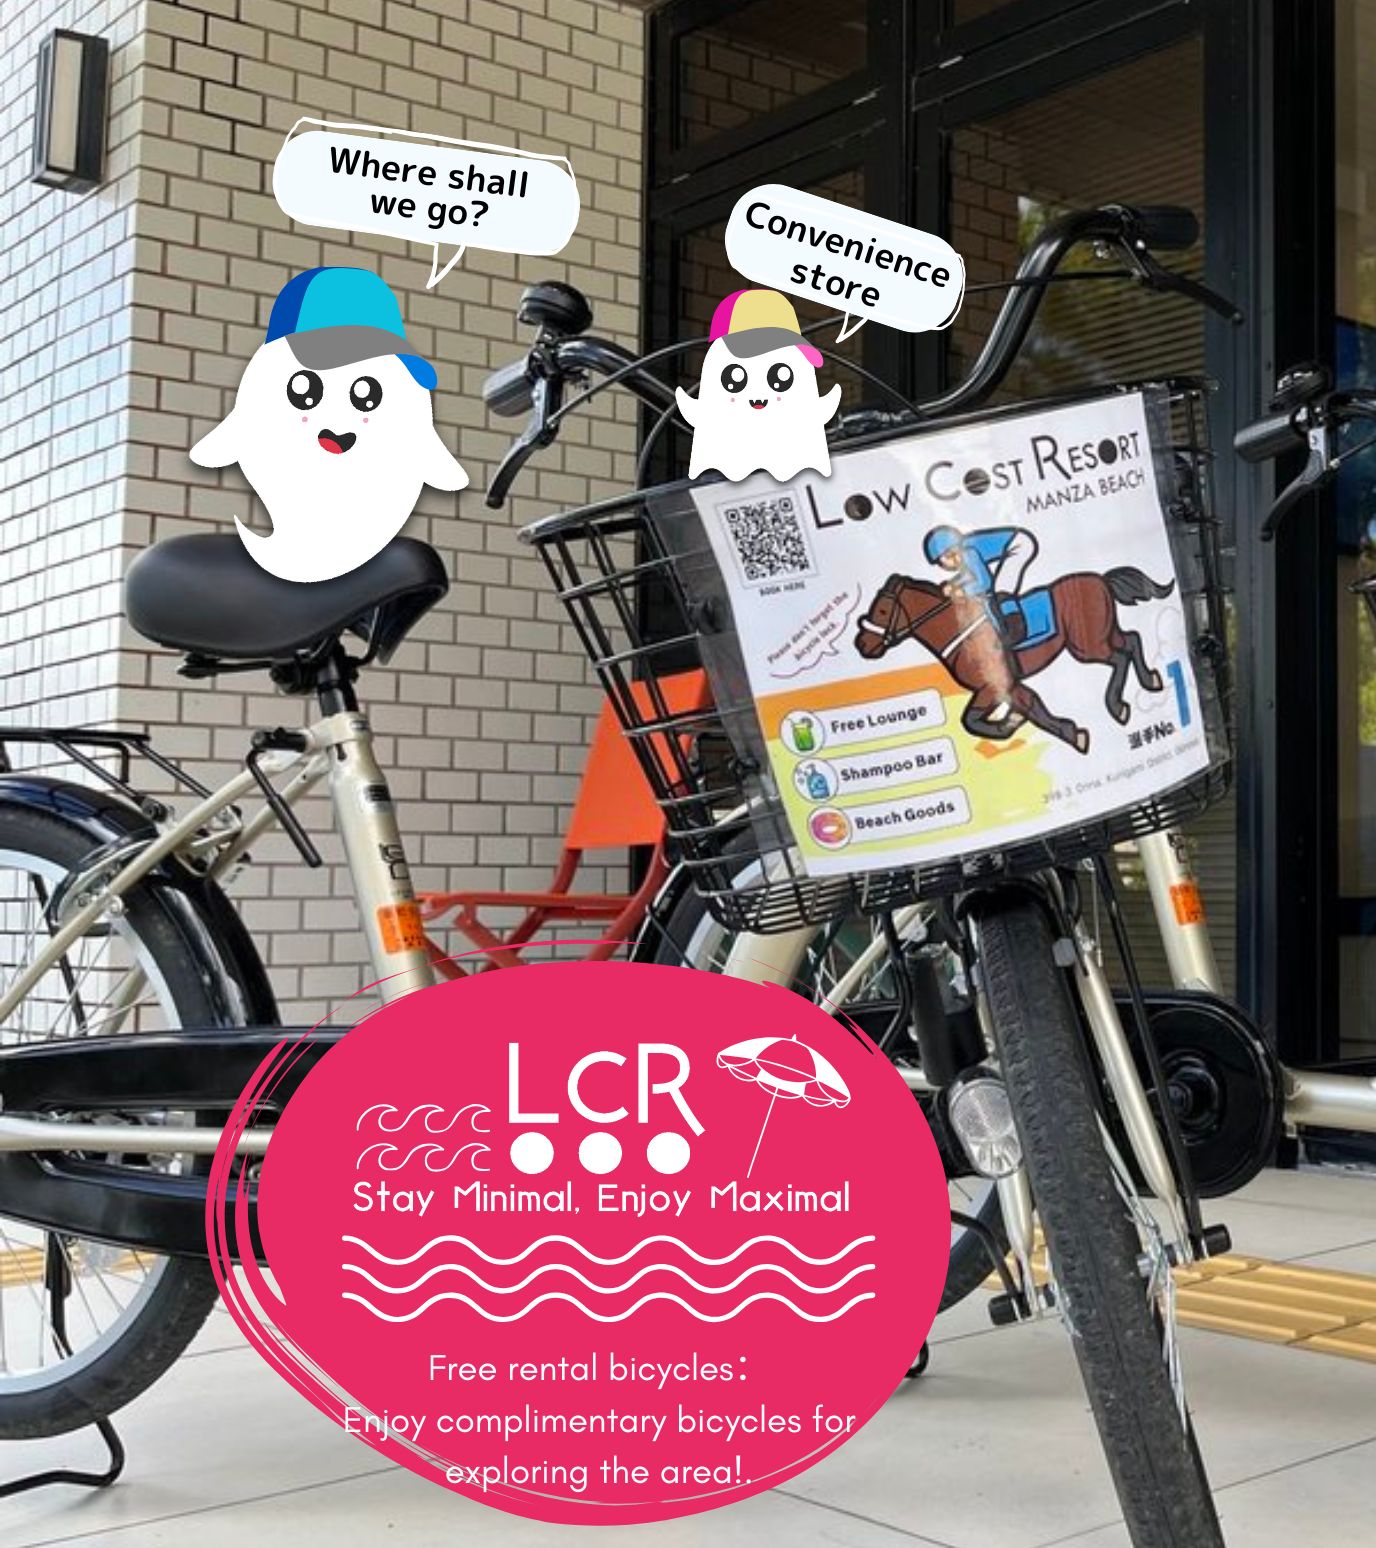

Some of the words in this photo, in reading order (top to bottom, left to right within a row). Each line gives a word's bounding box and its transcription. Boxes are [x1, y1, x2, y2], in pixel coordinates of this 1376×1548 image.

[1026, 484, 1097, 514] MANZA
[1099, 468, 1145, 493] BEACH
[1166, 659, 1191, 728] 1
[831, 720, 865, 734] Free
[867, 705, 927, 727] Lounge
[840, 759, 913, 782] Shampoo
[915, 752, 943, 767] Bar
[854, 812, 902, 829] Beach
[905, 801, 955, 820] Goods
